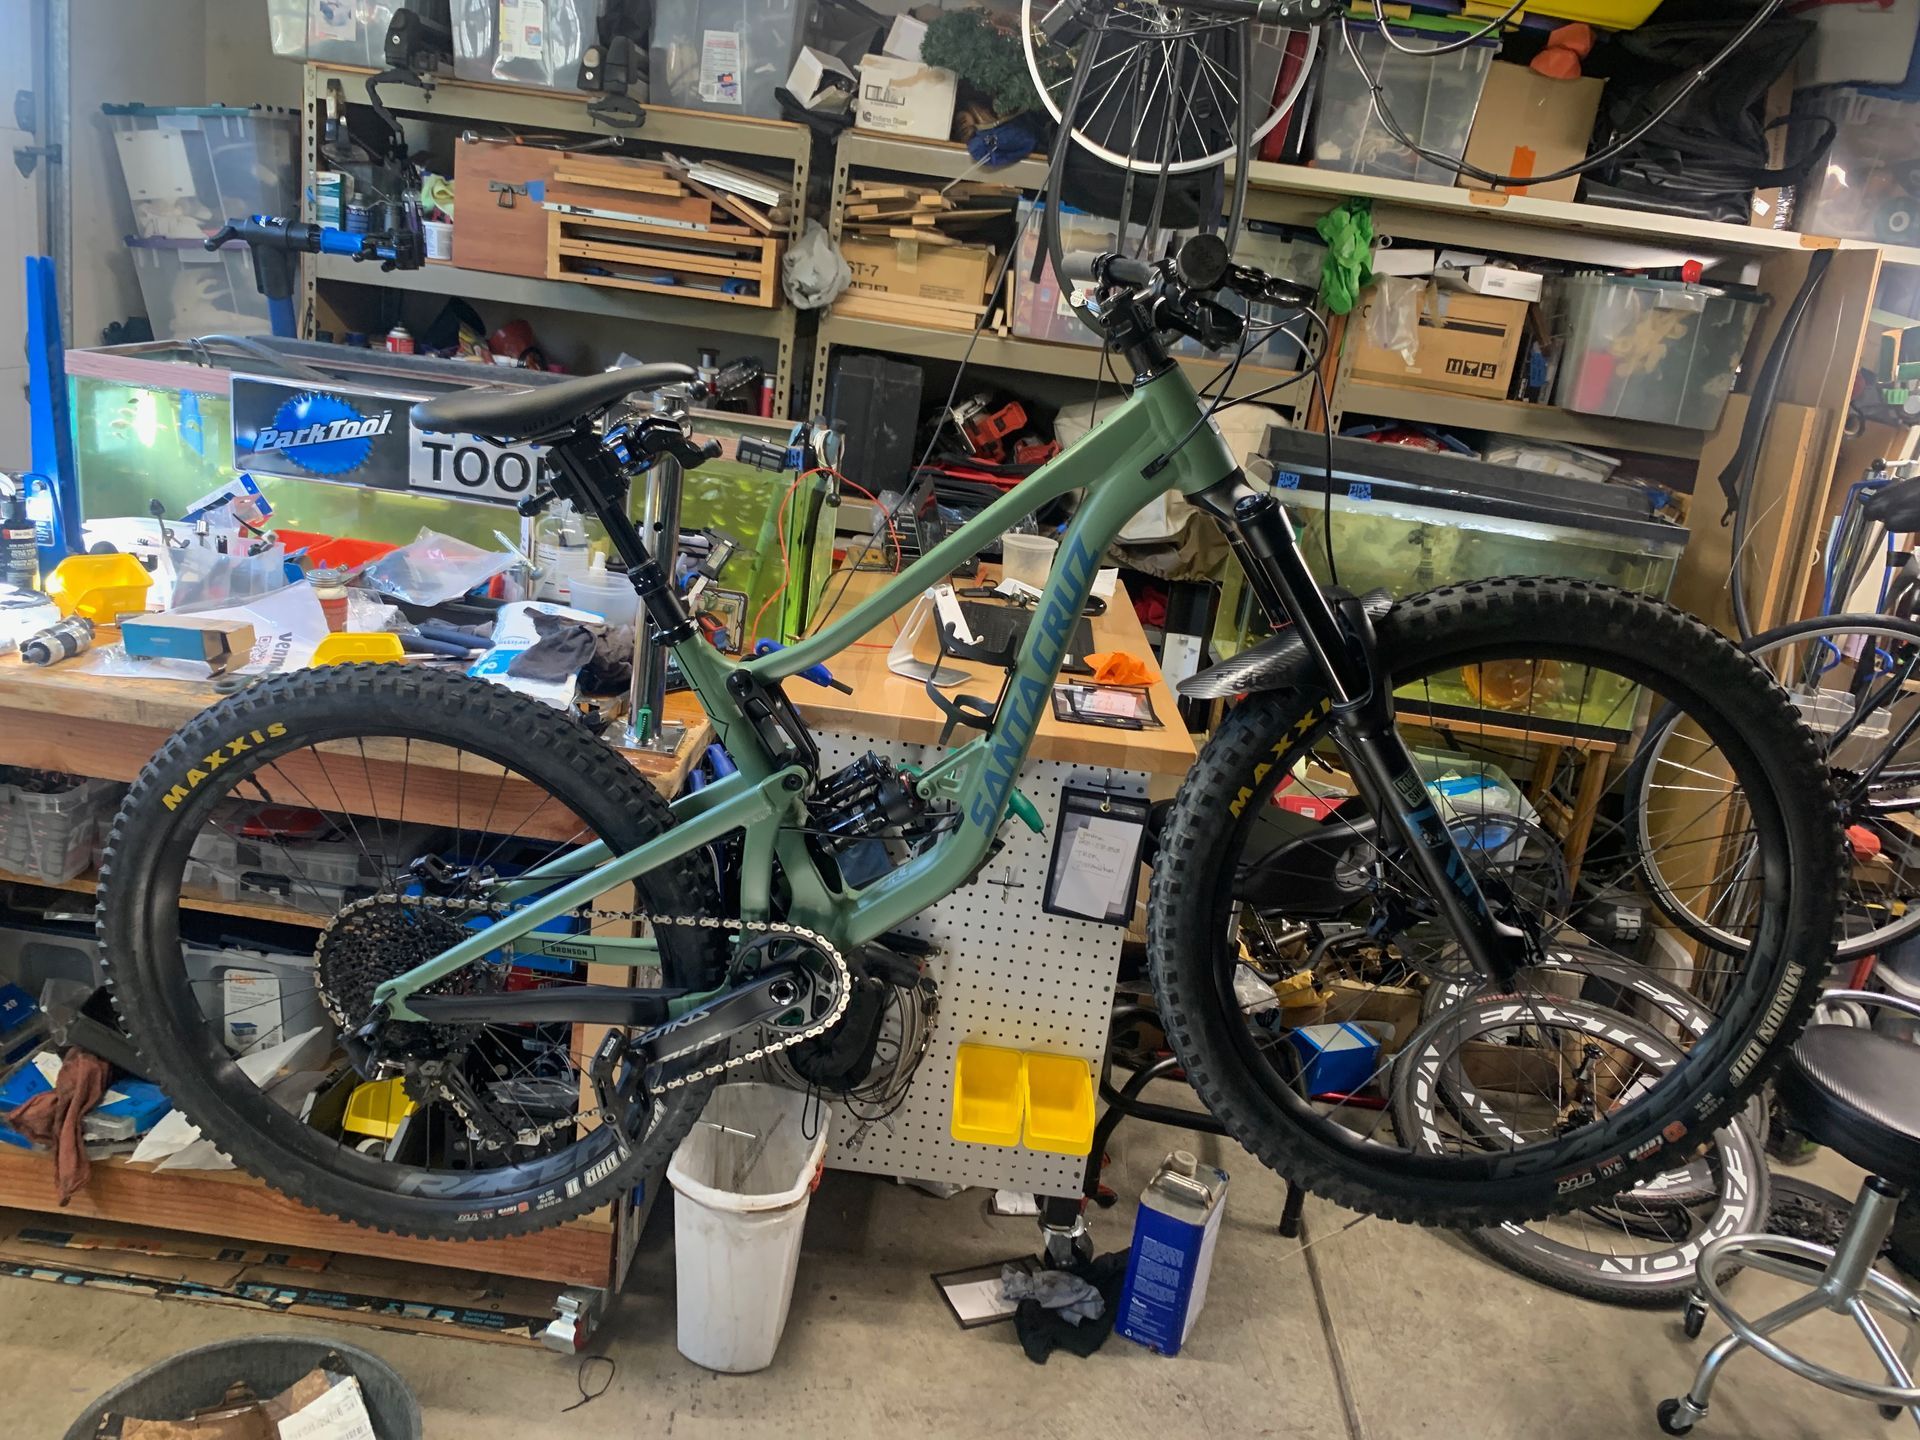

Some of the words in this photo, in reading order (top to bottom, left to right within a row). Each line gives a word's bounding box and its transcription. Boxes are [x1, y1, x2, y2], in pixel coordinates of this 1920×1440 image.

[1032, 533, 1098, 676] CRUZ
[161, 722, 288, 812] MAXXIS
[970, 676, 1047, 839] SANTA
[1228, 696, 1332, 820] MAXXI
[550, 944, 588, 956] BRONSON
[1755, 959, 1806, 1047] MINION
[1728, 1036, 1767, 1089] DHF
[584, 1156, 617, 1188] DHR
